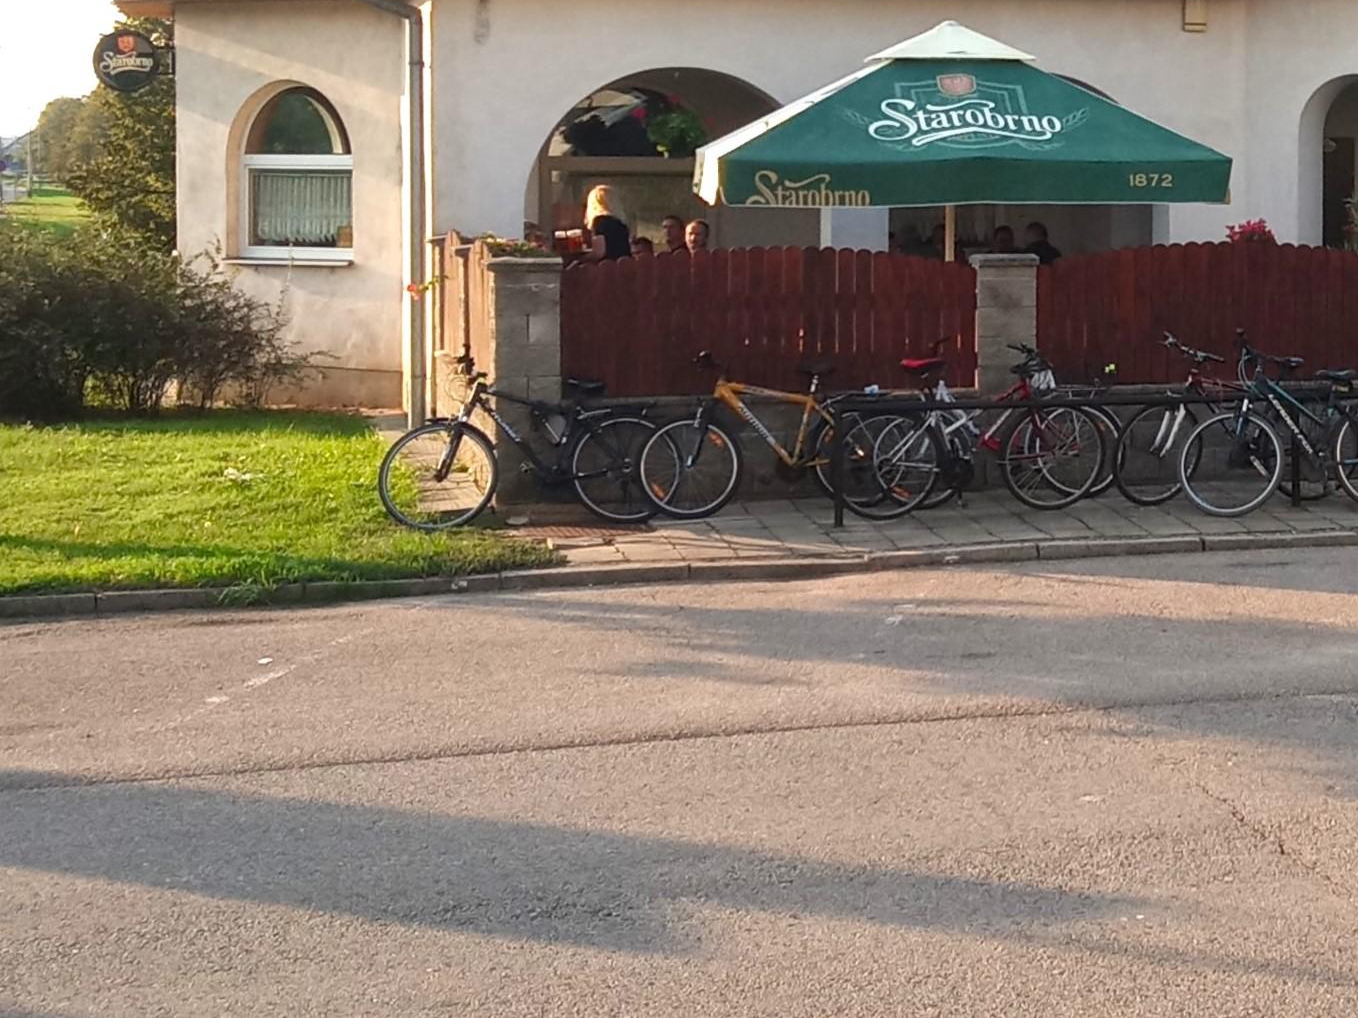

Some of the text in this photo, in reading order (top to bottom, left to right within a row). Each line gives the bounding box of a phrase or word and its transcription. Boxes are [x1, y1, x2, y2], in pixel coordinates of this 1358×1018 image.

[868, 98, 1062, 146] Starobrno
[745, 170, 870, 206] Starobrno
[1129, 173, 1173, 187] 1872
